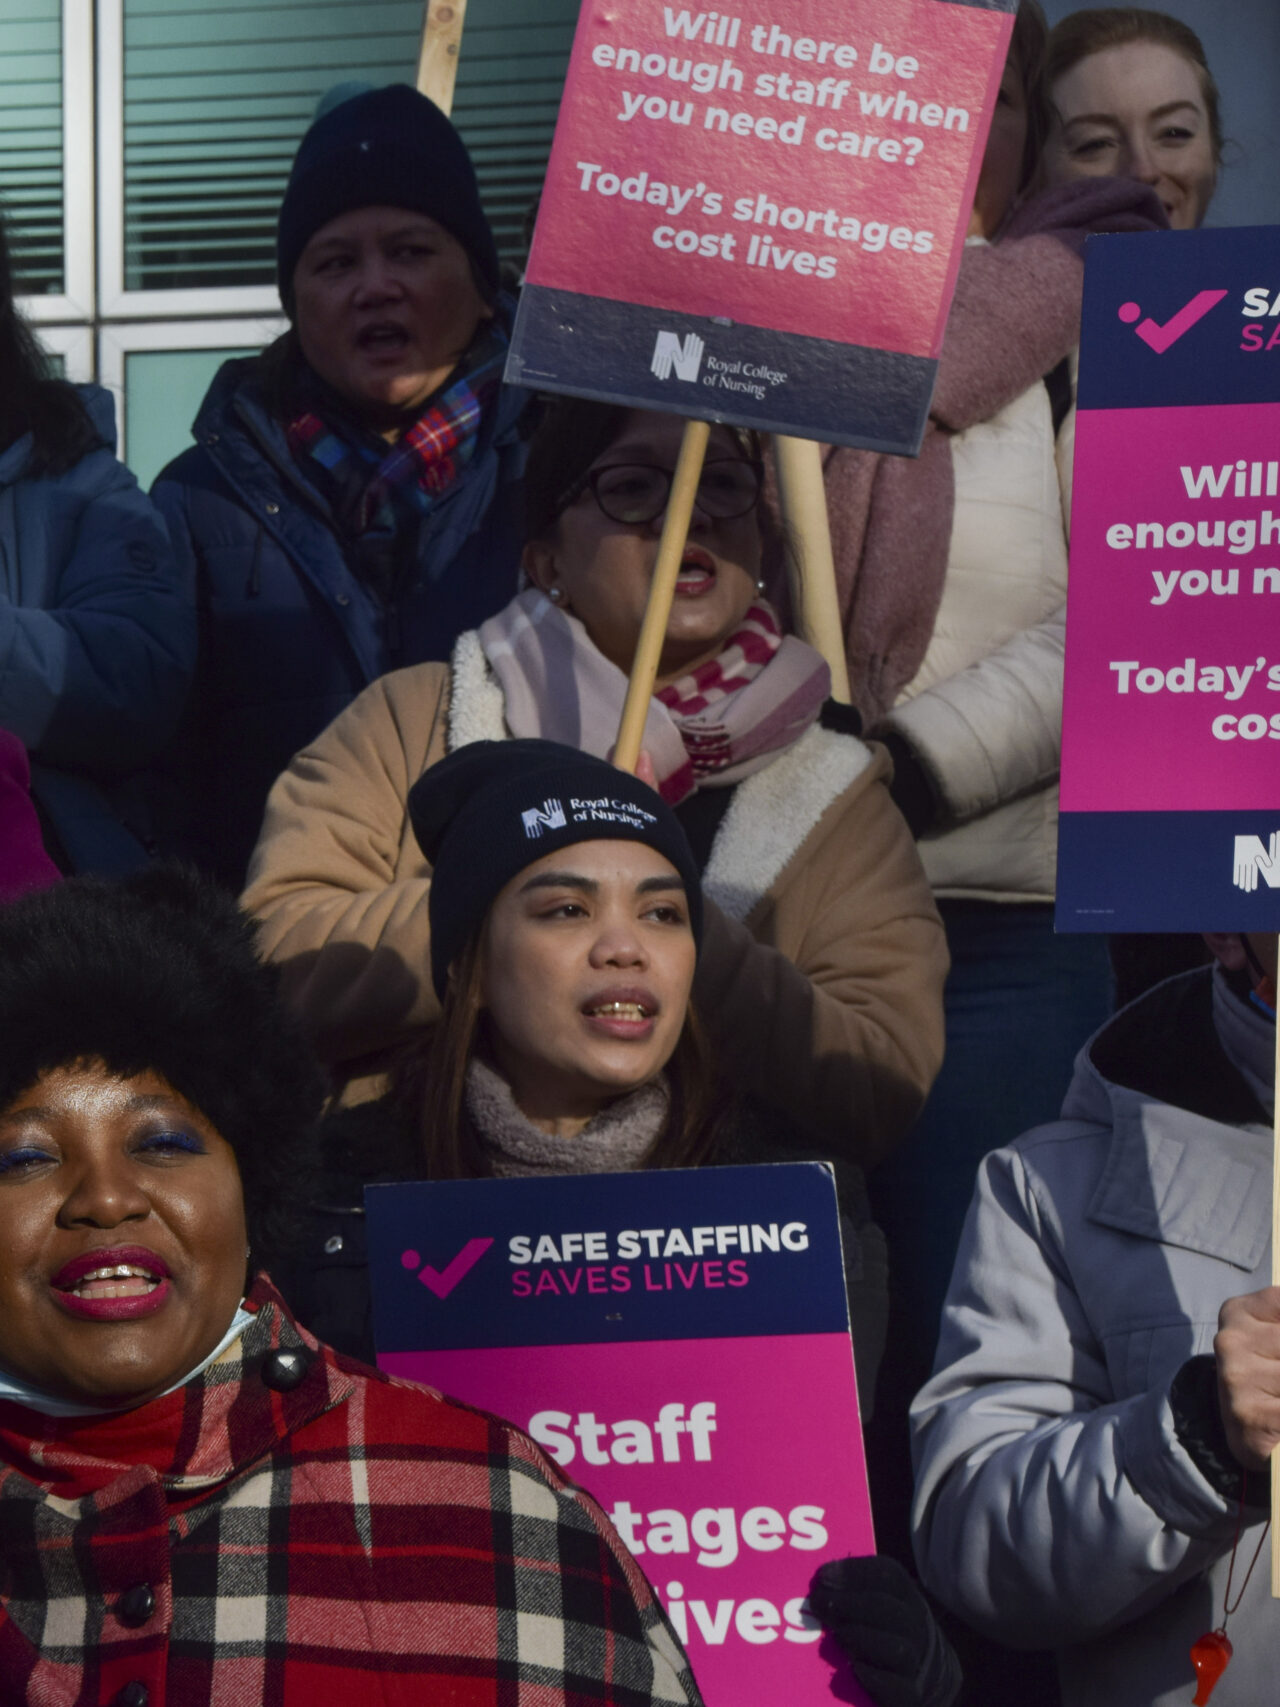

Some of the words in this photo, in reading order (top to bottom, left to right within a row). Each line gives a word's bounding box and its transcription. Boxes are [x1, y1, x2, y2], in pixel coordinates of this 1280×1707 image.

[663, 7, 741, 47] Will
[751, 25, 858, 68] there
[868, 43, 919, 79] be
[592, 44, 744, 93] enough
[754, 72, 851, 109] staff
[856, 89, 969, 133] when
[618, 91, 694, 125] you
[704, 107, 806, 145] need
[815, 128, 924, 165] care?
[577, 162, 723, 215] Today's
[733, 194, 934, 254] shortages
[653, 226, 736, 261] cost
[747, 235, 838, 278] lives
[703, 373, 719, 386] of
[718, 374, 765, 400] Nursing
[708, 357, 741, 373] Royal
[743, 364, 787, 385] College
[1180, 460, 1278, 498] Will
[1151, 569, 1239, 605] you
[1212, 714, 1280, 740] cos
[570, 797, 608, 812] Royal
[573, 811, 587, 822] of
[509, 1233, 608, 1263] SAFE
[618, 1222, 808, 1258] STAFFING
[512, 1265, 632, 1297] SAVES
[644, 1260, 749, 1290] LIVES
[527, 1402, 716, 1465] Staff
[610, 1502, 828, 1567] tages
[655, 1581, 821, 1645] ives
